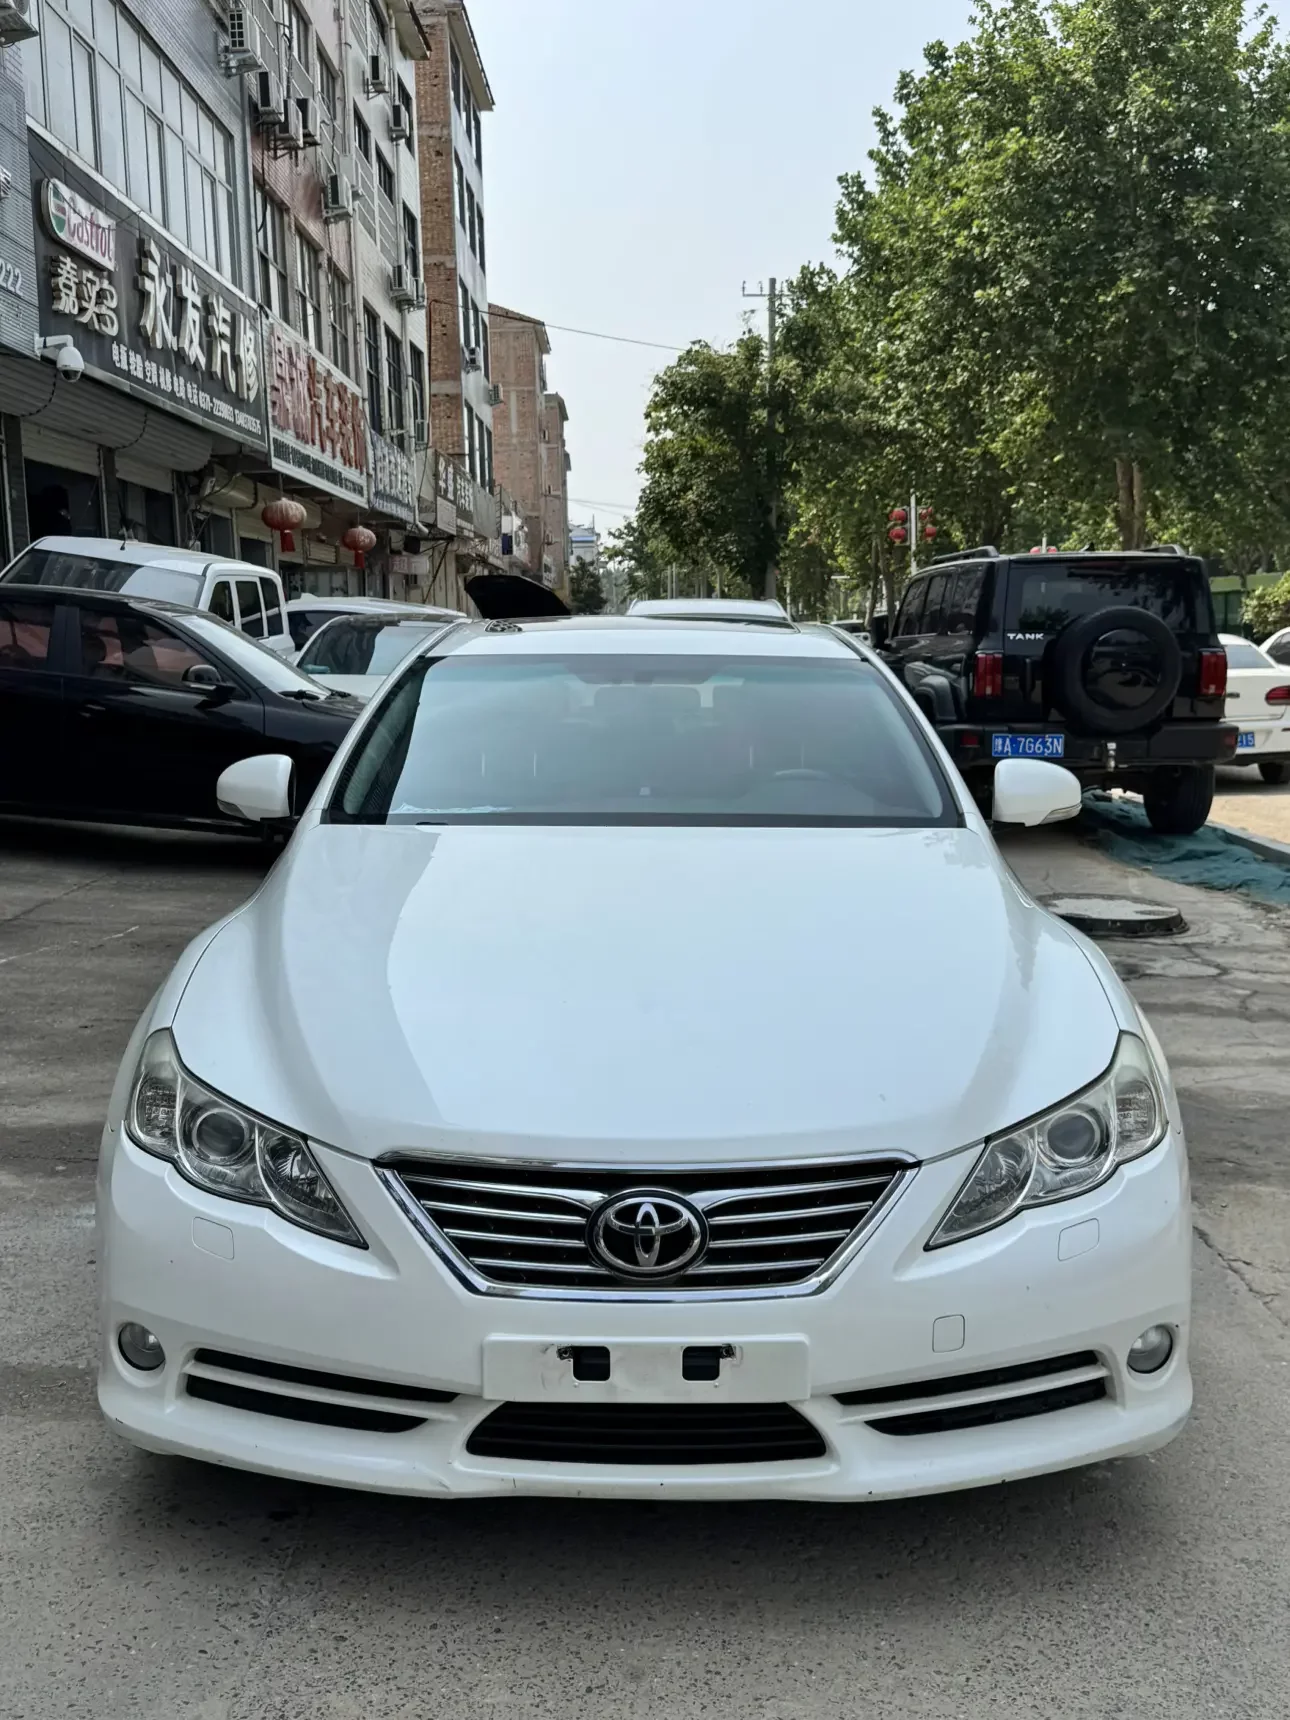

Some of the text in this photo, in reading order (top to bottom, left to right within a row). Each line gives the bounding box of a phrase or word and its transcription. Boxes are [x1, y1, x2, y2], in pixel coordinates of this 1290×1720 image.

[67, 196, 113, 260] Castrol
[53, 255, 119, 336] 嘉实多
[139, 238, 259, 403] 永发汽修
[1007, 632, 1045, 640] TANK
